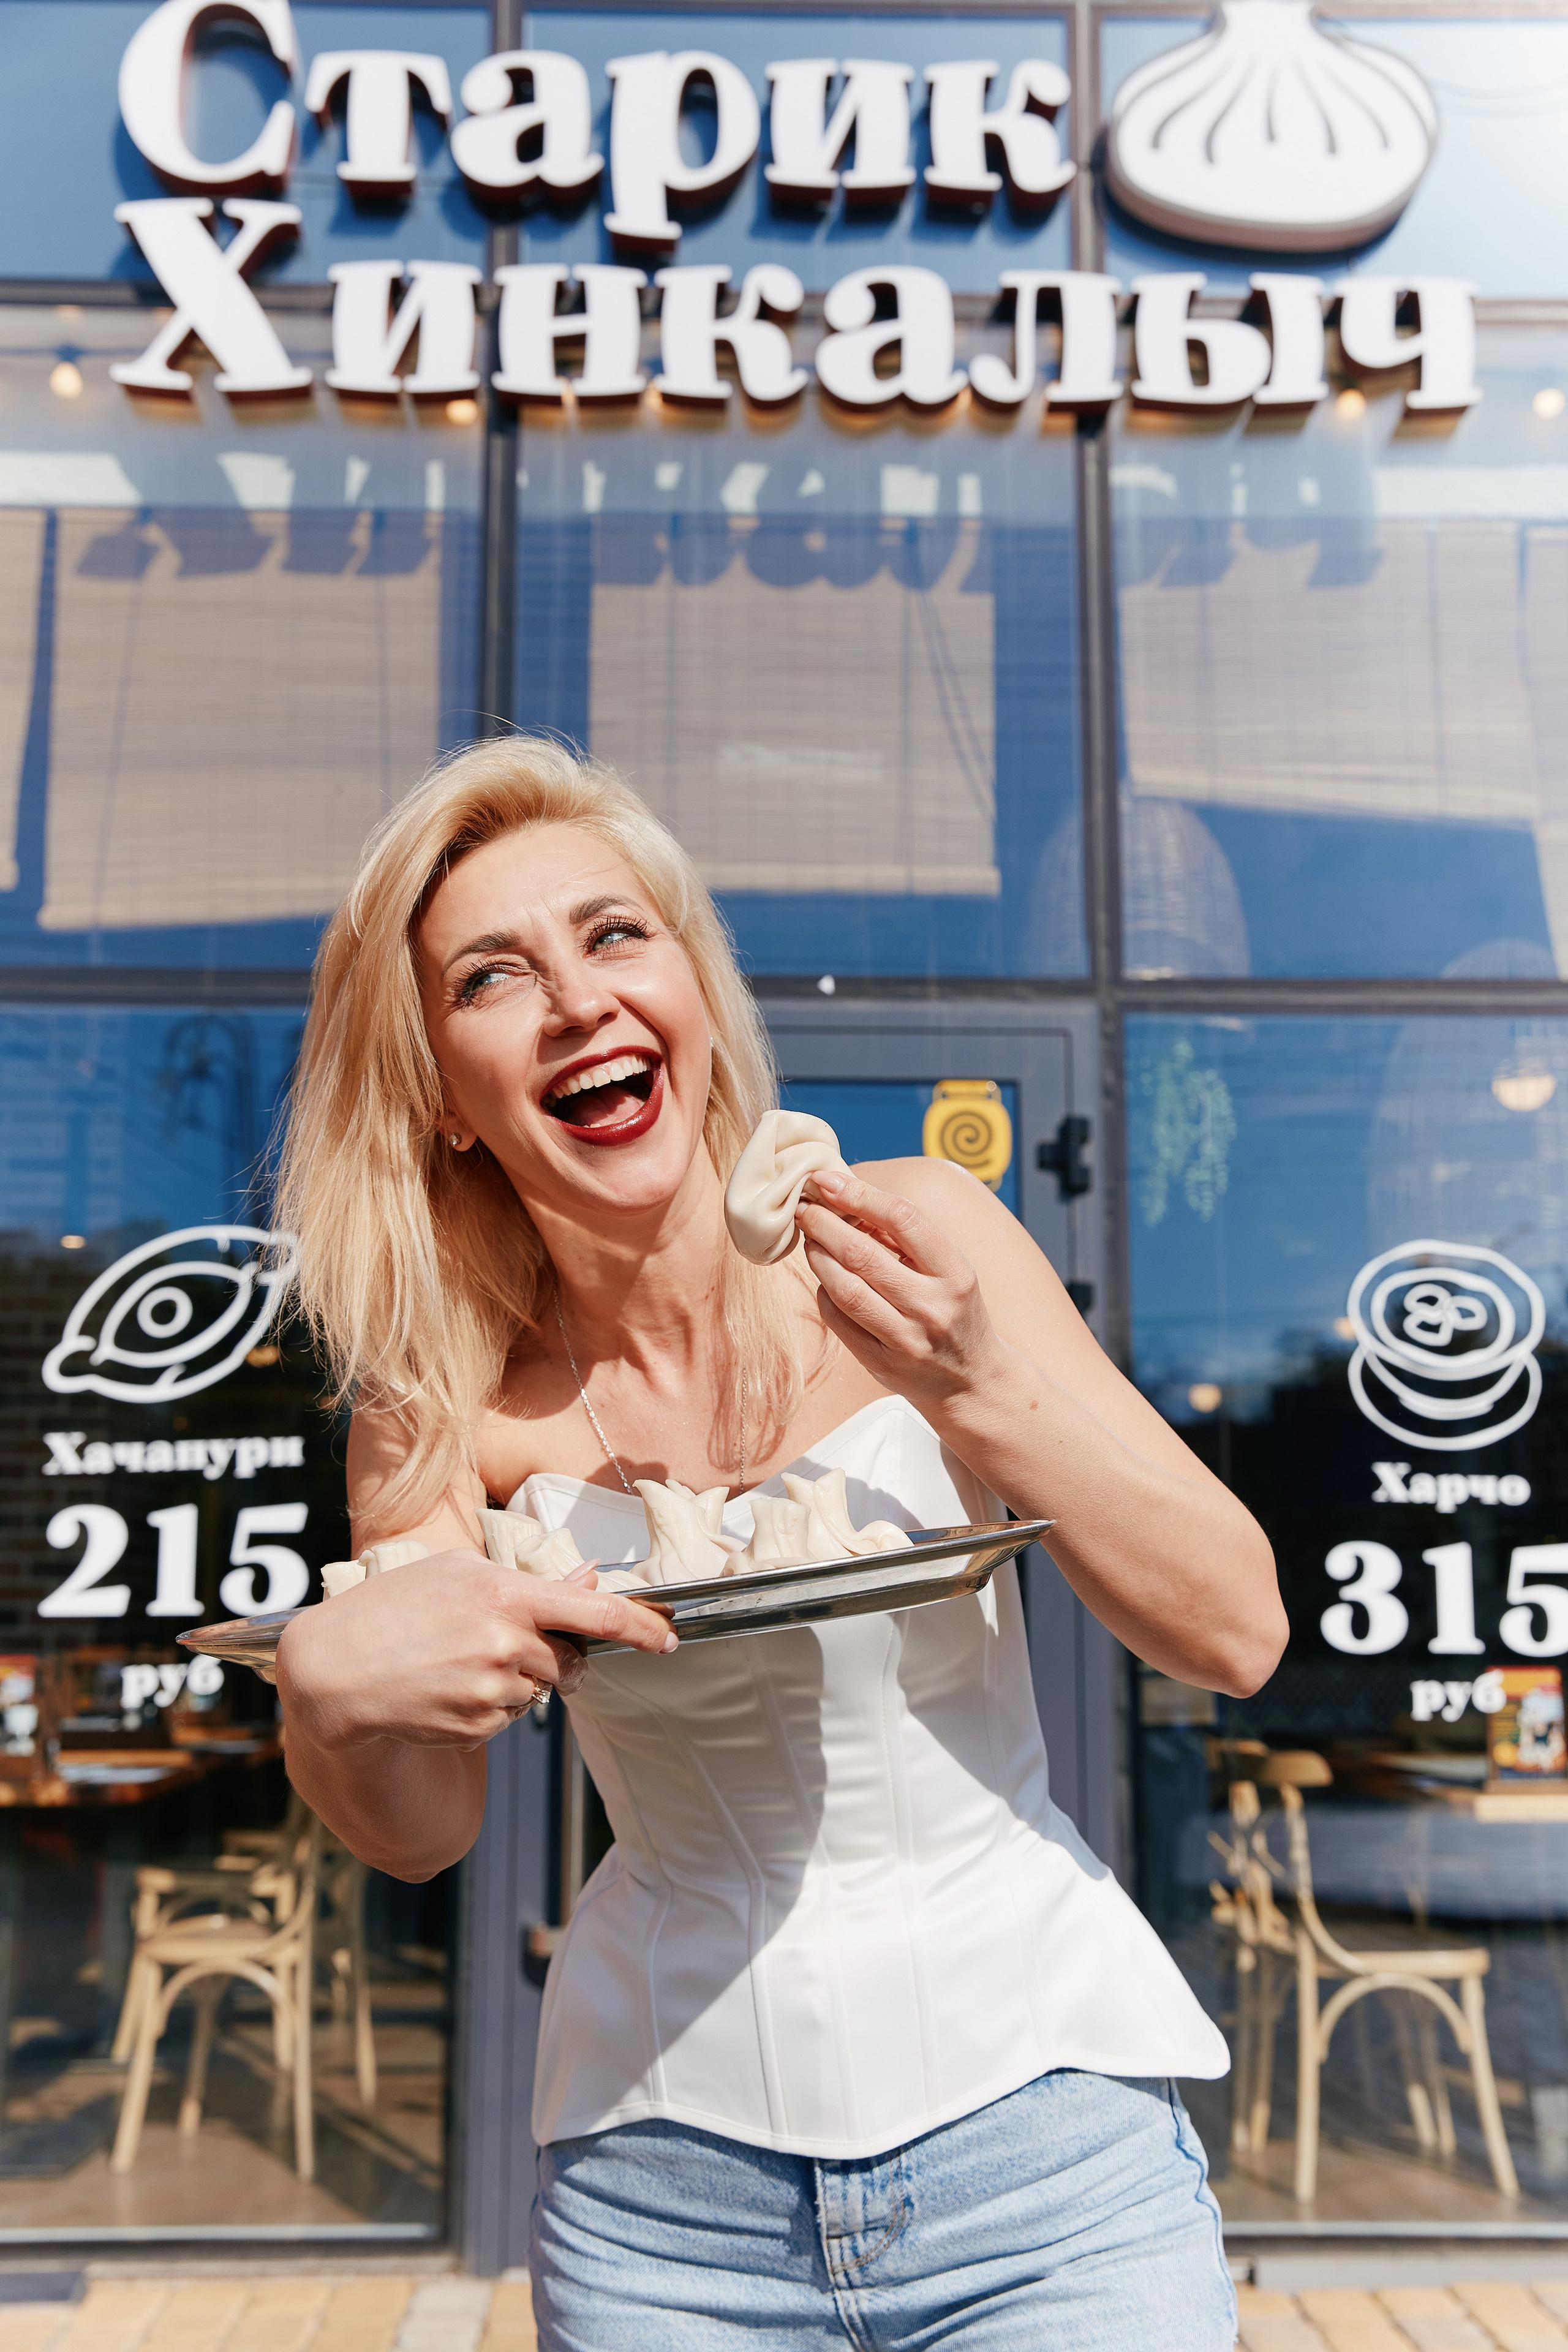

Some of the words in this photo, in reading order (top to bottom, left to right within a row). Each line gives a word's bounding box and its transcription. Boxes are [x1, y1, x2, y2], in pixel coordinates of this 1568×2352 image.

[117, 0, 1077, 239] Старик
[111, 197, 1481, 414] Хинкалыч
[42, 1431, 304, 1479] Хачапури
[1372, 1462, 1532, 1513] Харчо
[37, 1503, 309, 1618] 215
[1321, 1541, 1568, 1657] 315
[121, 1653, 224, 1708] руб
[1411, 1669, 1507, 1722] руб
